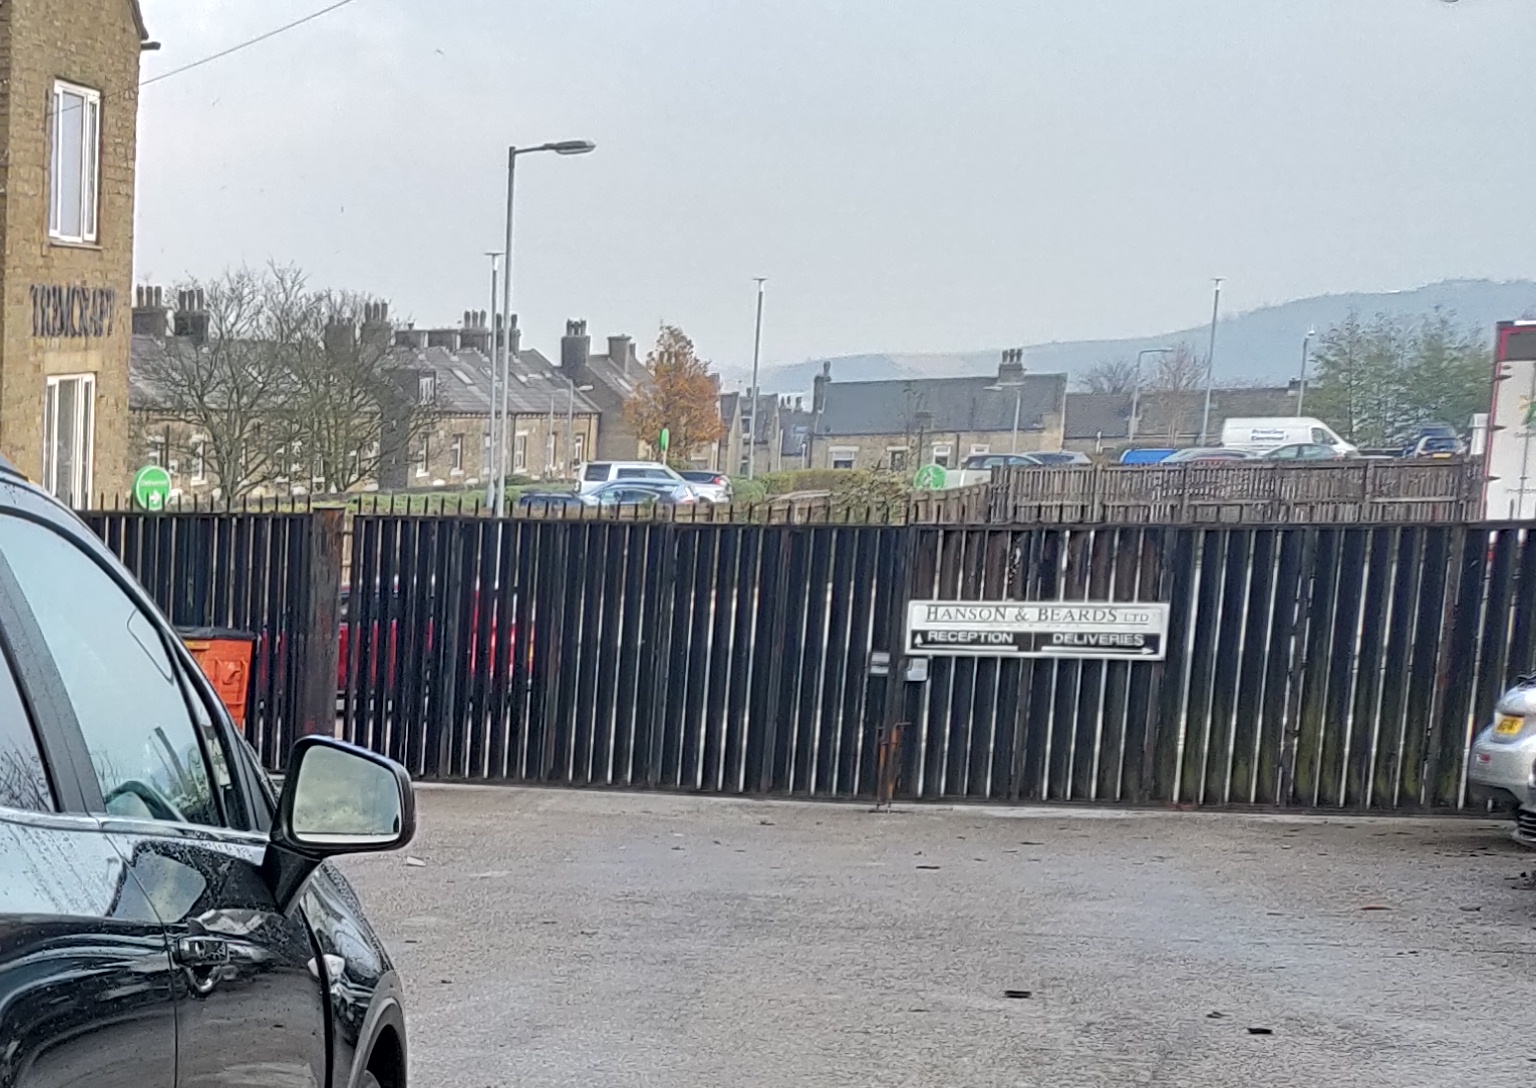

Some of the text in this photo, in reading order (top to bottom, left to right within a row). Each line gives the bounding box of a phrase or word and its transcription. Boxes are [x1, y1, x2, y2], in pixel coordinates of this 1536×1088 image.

[926, 606, 1007, 621] HANSON
[1014, 607, 1030, 621] &
[1038, 607, 1118, 622] BEARDS
[928, 630, 1014, 643] RECEPTION
[1052, 633, 1145, 647] DELIVERIES
